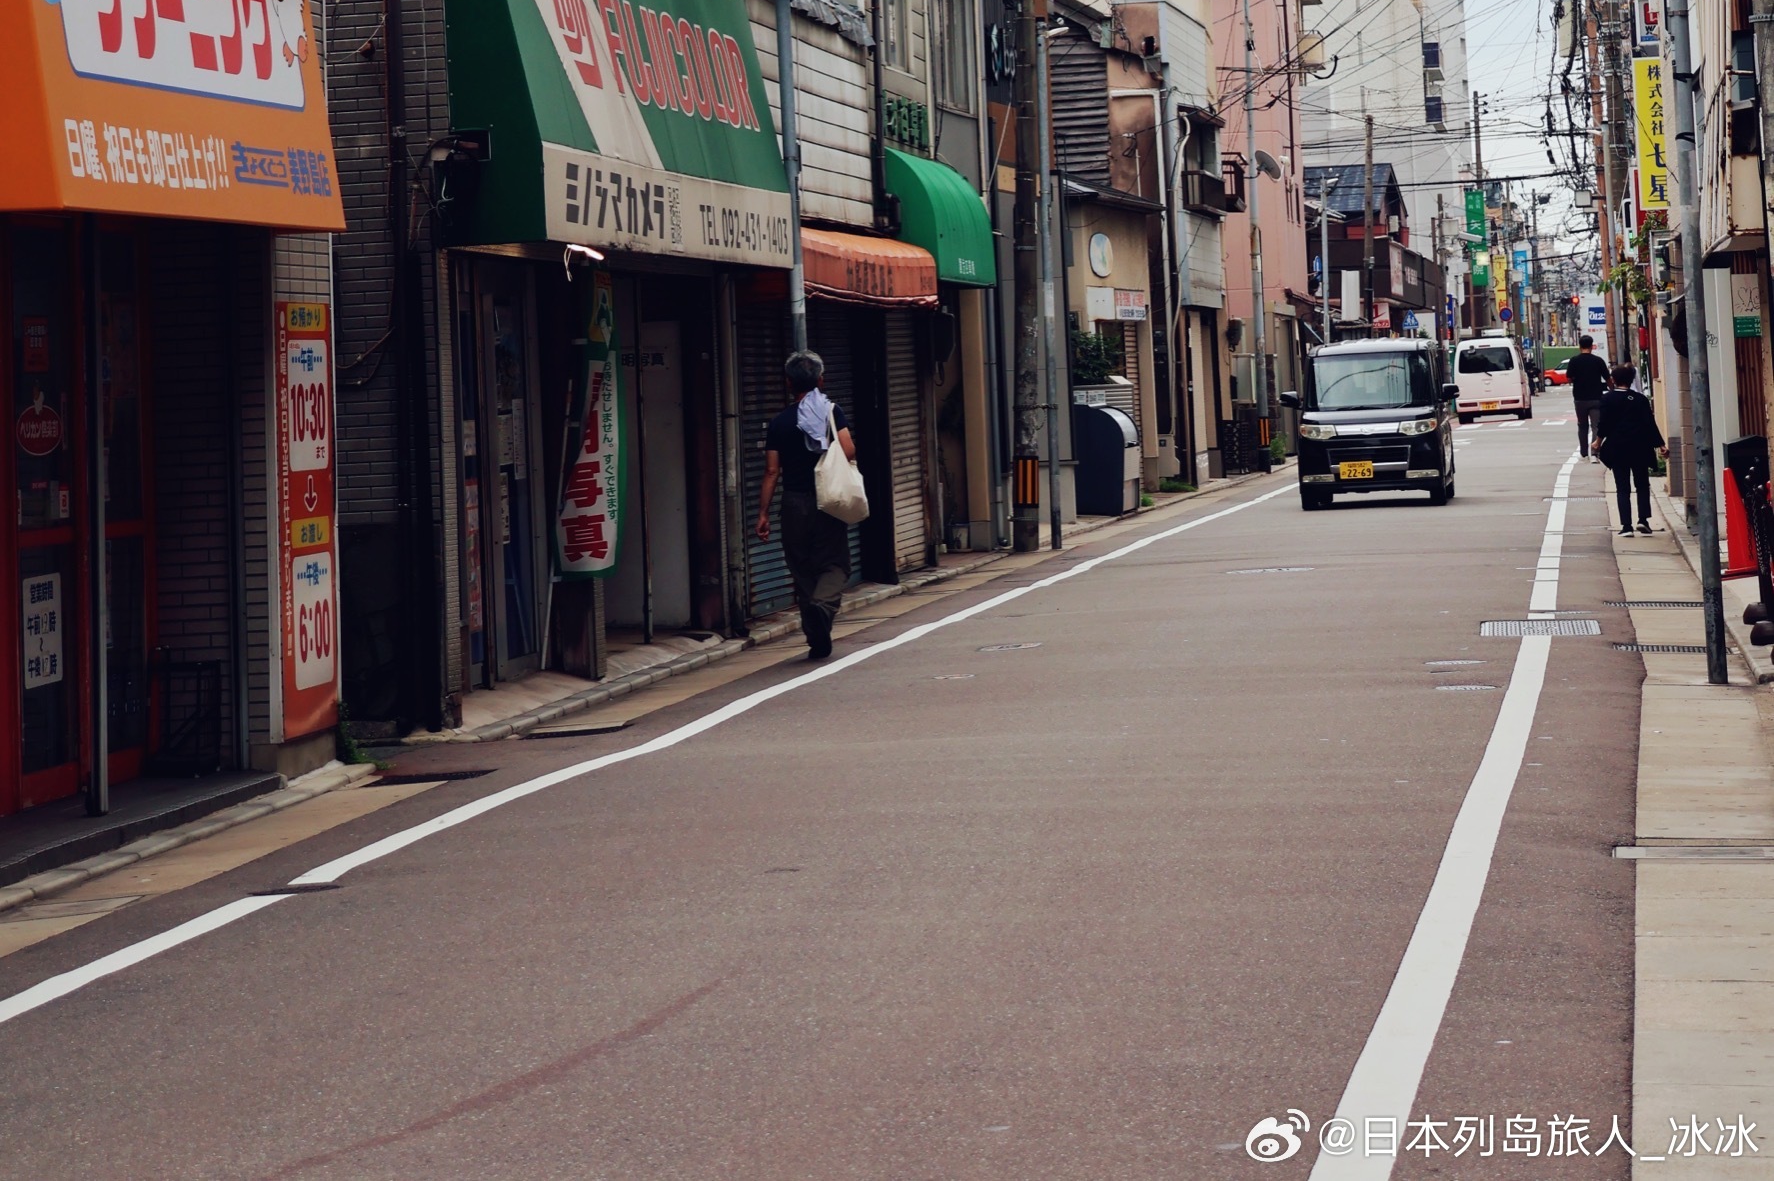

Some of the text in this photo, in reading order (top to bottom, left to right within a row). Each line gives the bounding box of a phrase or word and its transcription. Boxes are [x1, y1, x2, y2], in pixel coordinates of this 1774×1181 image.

[565, 161, 666, 240] ミノシマカメラ
[699, 204, 719, 246] TEL
[721, 207, 789, 255] 092-431-1403
[290, 306, 321, 328] お預かり
[300, 347, 314, 373] 午前
[290, 382, 326, 443] 10:30
[316, 445, 325, 459] まで
[1347, 467, 1372, 478] 22-69
[306, 561, 321, 587] 午後
[299, 597, 330, 664] 6:00
